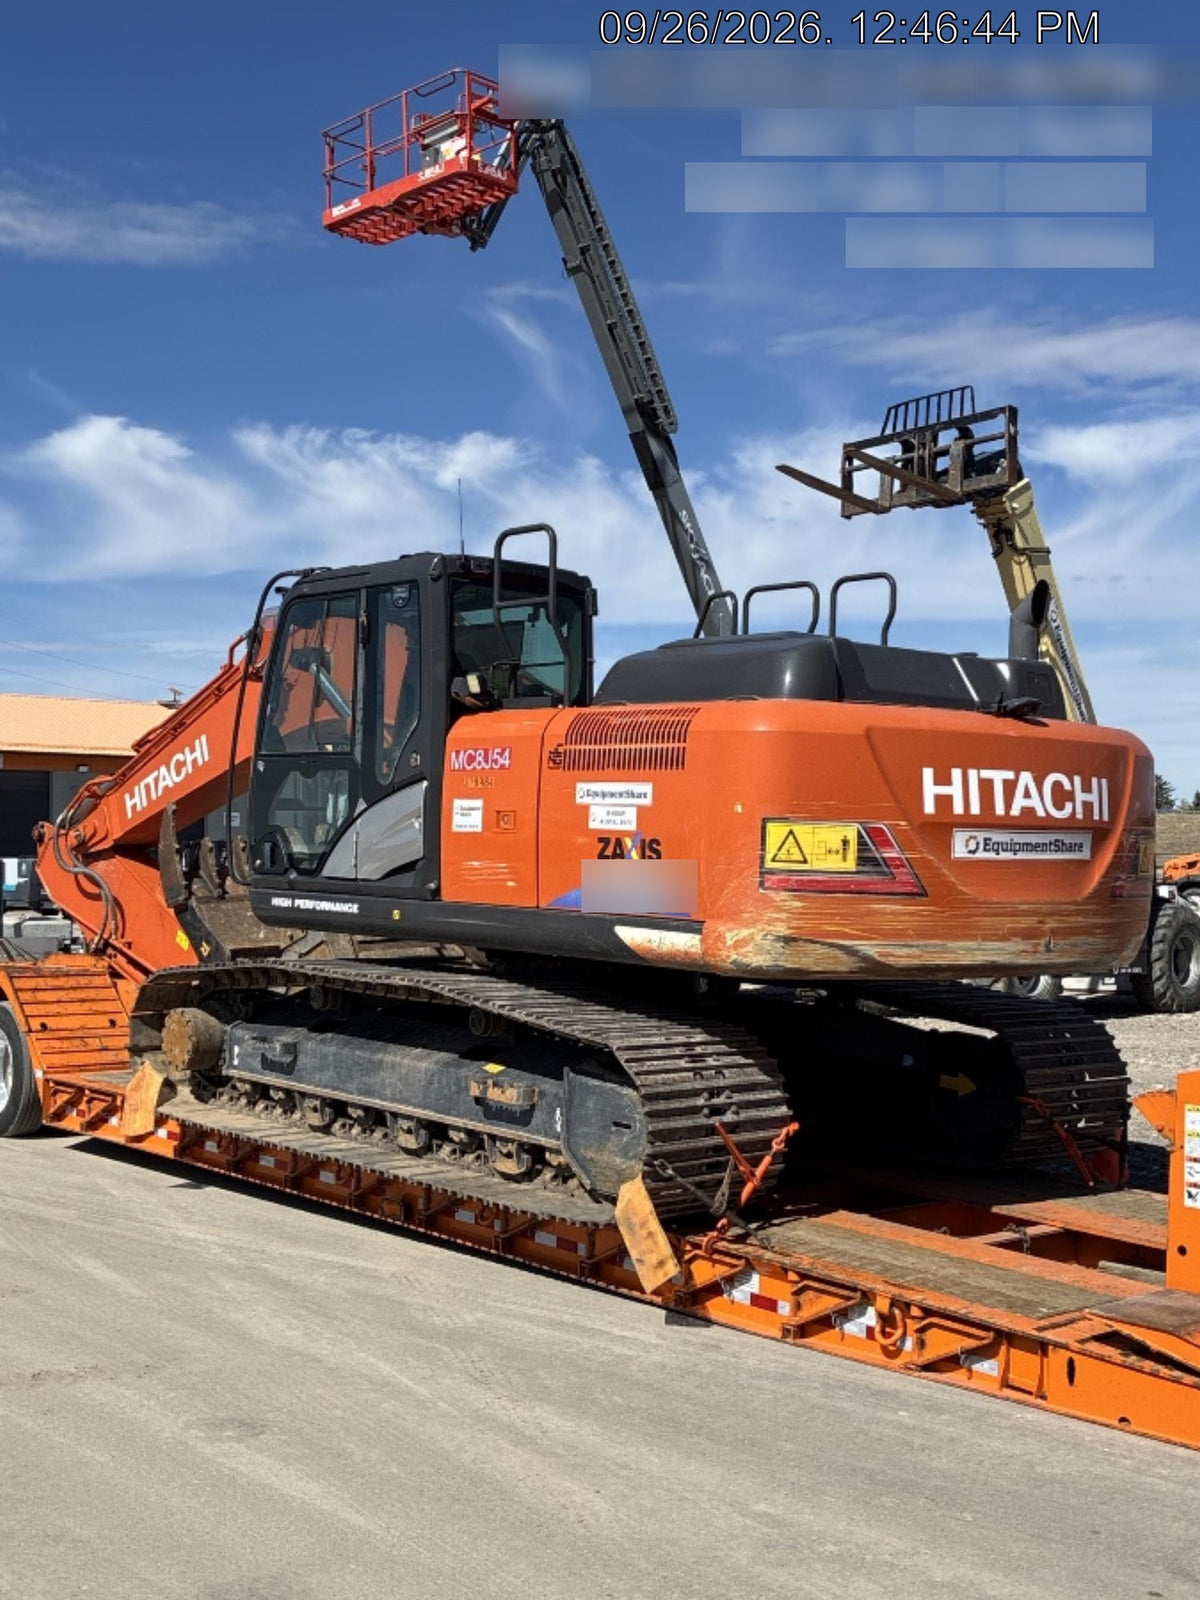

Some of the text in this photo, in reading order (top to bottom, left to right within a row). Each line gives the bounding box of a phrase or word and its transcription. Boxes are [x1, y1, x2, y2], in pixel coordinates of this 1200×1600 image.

[450, 748, 511, 771] MC8J54
[124, 733, 208, 820] HITACHI
[922, 767, 1109, 822] HITACHI
[597, 831, 662, 860] ZAXIS
[983, 837, 1084, 855] EquipmentShare
[294, 899, 359, 914] PERFORMANCE
